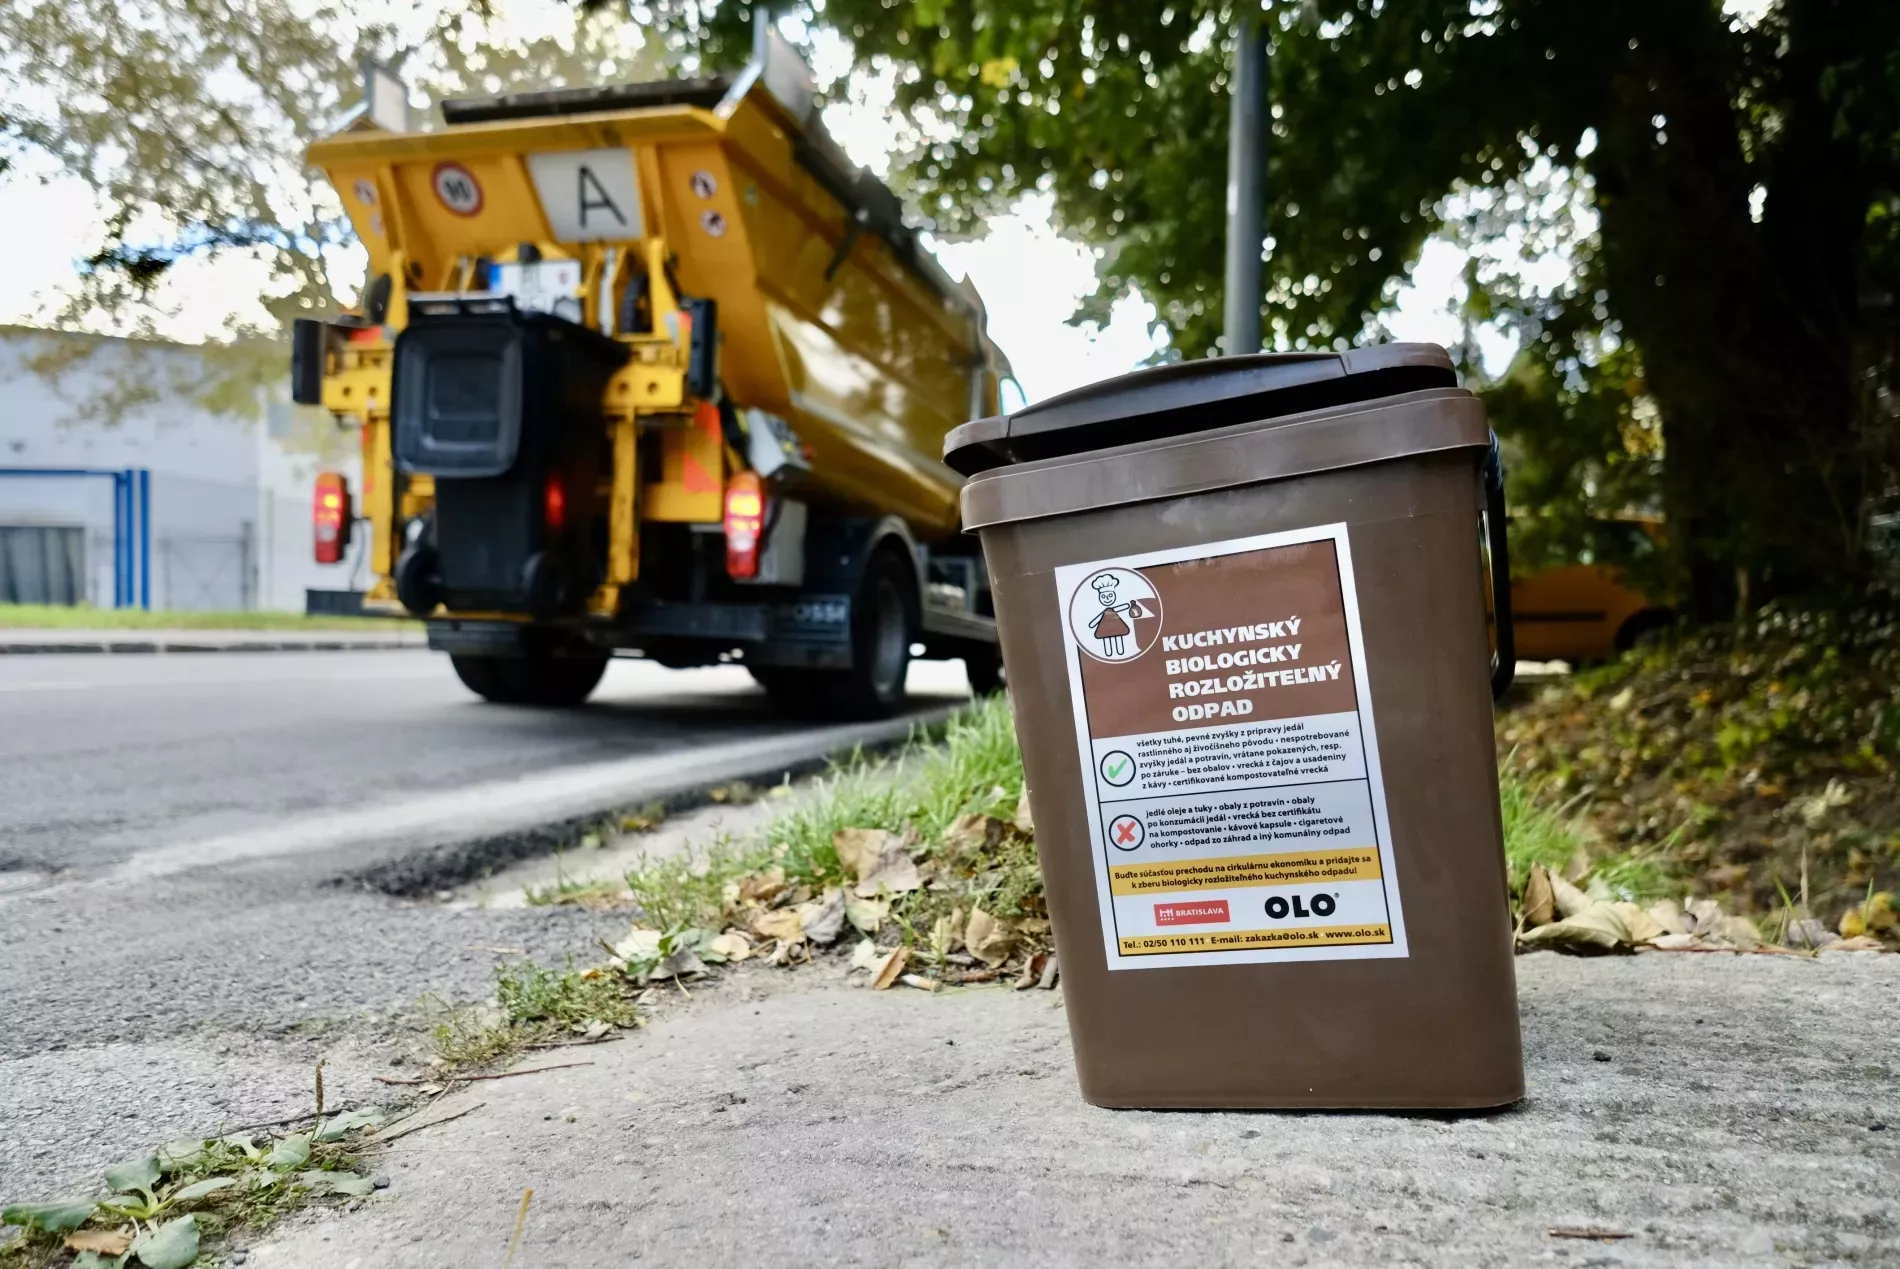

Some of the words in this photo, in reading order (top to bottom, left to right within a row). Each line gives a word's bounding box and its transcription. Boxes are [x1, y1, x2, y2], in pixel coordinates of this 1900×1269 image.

[578, 166, 628, 230] A
[1162, 616, 1301, 652] KUCHYNSKÝ
[1166, 644, 1302, 675] BIOLOGICKY
[1169, 660, 1342, 699] ROZLOŽITEĽNÝ
[1173, 699, 1253, 721] ODPAD
[1137, 739, 1162, 747] všetky
[1164, 736, 1184, 744] tuhé,
[1186, 733, 1210, 743] pevné
[1212, 730, 1239, 740] zvyšky
[1247, 727, 1281, 737] prípravy
[1284, 723, 1304, 734] jedál
[1138, 747, 1183, 757] rastlinného
[1185, 746, 1192, 754] aj
[1193, 741, 1240, 752] živočíšneho
[1242, 738, 1274, 748] pôvodu
[1281, 730, 1349, 743] nespotrebované
[1140, 760, 1166, 769] zvyšky
[1167, 757, 1187, 767] jedál
[1195, 753, 1231, 764] potravín,
[1233, 751, 1264, 759] vrátane
[1266, 744, 1319, 757] pokazených,
[1153, 769, 1179, 777] záruke
[1203, 764, 1230, 772] obalov
[1237, 760, 1264, 769] vrecká
[1272, 758, 1294, 767] čajov
[1303, 753, 1346, 763] usadeniny
[1173, 775, 1225, 786] certifikované
[1227, 768, 1299, 781] kompostovateľné
[1301, 765, 1329, 774] vrecká
[1146, 809, 1165, 819] jedlé
[1167, 808, 1186, 816] oleje
[1194, 805, 1213, 813] tuky
[1219, 802, 1241, 811] obaly
[1250, 799, 1285, 810] potravín
[1292, 796, 1315, 805] obaly
[1159, 816, 1205, 826] konzumácii
[1206, 814, 1226, 824] jedál
[1233, 811, 1260, 820] vrecká
[1278, 807, 1321, 816] certifikátu
[1151, 840, 1178, 848] ohorky
[1185, 837, 1210, 846] odpad
[1223, 834, 1251, 843] záhrad
[1259, 832, 1272, 841] iný
[1274, 829, 1321, 839] komunálny
[1323, 826, 1351, 836] odpad
[1160, 826, 1222, 837] kompostovanie
[1228, 822, 1258, 831] kávové
[1259, 820, 1292, 830] kapsule
[1299, 816, 1343, 827] cigaretové
[1140, 869, 1174, 877] súčasťou
[1176, 866, 1214, 876] prechodu
[1227, 863, 1269, 871] cirkulárnu
[1270, 859, 1317, 868] ekonomiku
[1326, 856, 1360, 866] pridajte
[1162, 877, 1203, 887] biologicky
[1205, 873, 1263, 883] rozložiteľného
[1264, 870, 1320, 880] kuchynského
[1321, 867, 1357, 877] odpadu!
[1176, 908, 1224, 916] BRATISLAVA
[1123, 941, 1141, 949] Tel.:
[1211, 935, 1243, 944] E-mail:
[1246, 931, 1319, 942] zakazka@olo.sk
[1325, 928, 1385, 938] www.olo.sk
